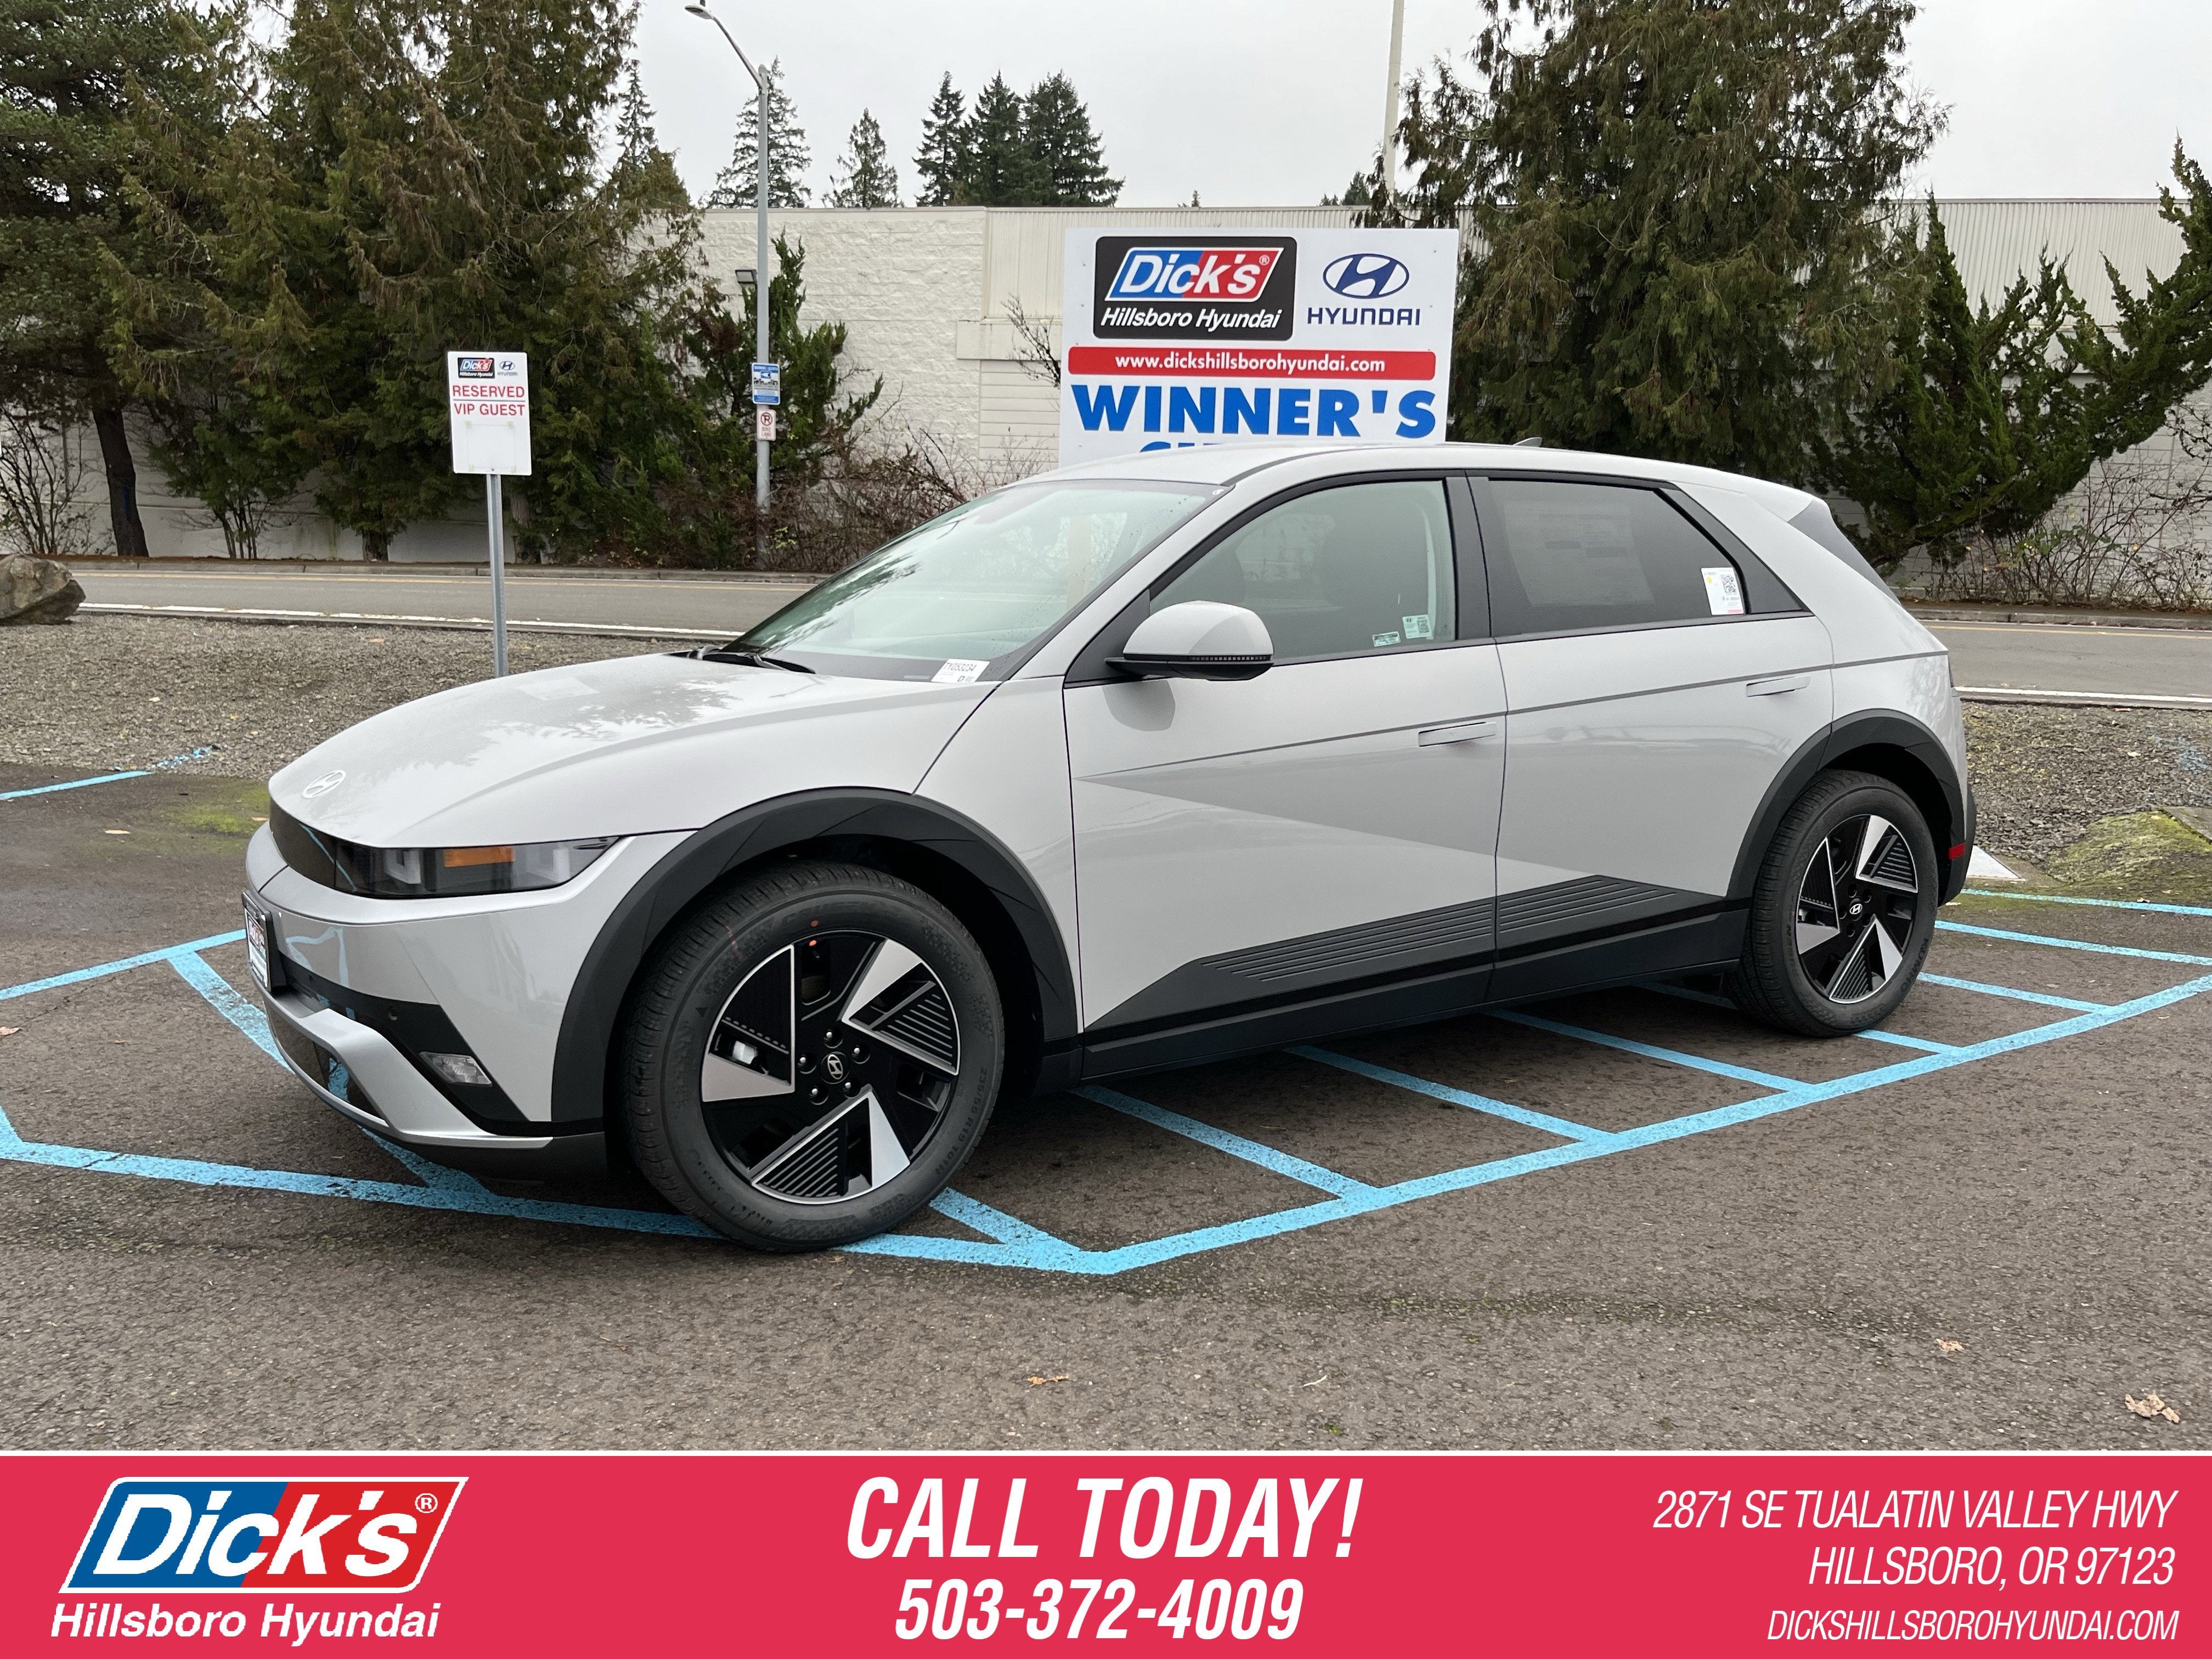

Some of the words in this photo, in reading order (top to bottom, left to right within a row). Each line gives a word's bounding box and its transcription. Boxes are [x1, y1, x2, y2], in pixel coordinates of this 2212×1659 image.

[1119, 253, 1261, 295] Dick's
[1101, 307, 1193, 327] Hillsboro
[1195, 308, 1283, 332] Hyundai
[1307, 307, 1421, 326] HYUNDAI
[1115, 351, 1385, 375] www.dickshillsborohyundai.com
[453, 385, 525, 397] RESERVED
[454, 403, 475, 415] VIP
[479, 404, 525, 416] GUEST
[1071, 383, 1436, 439] WINNER'S
